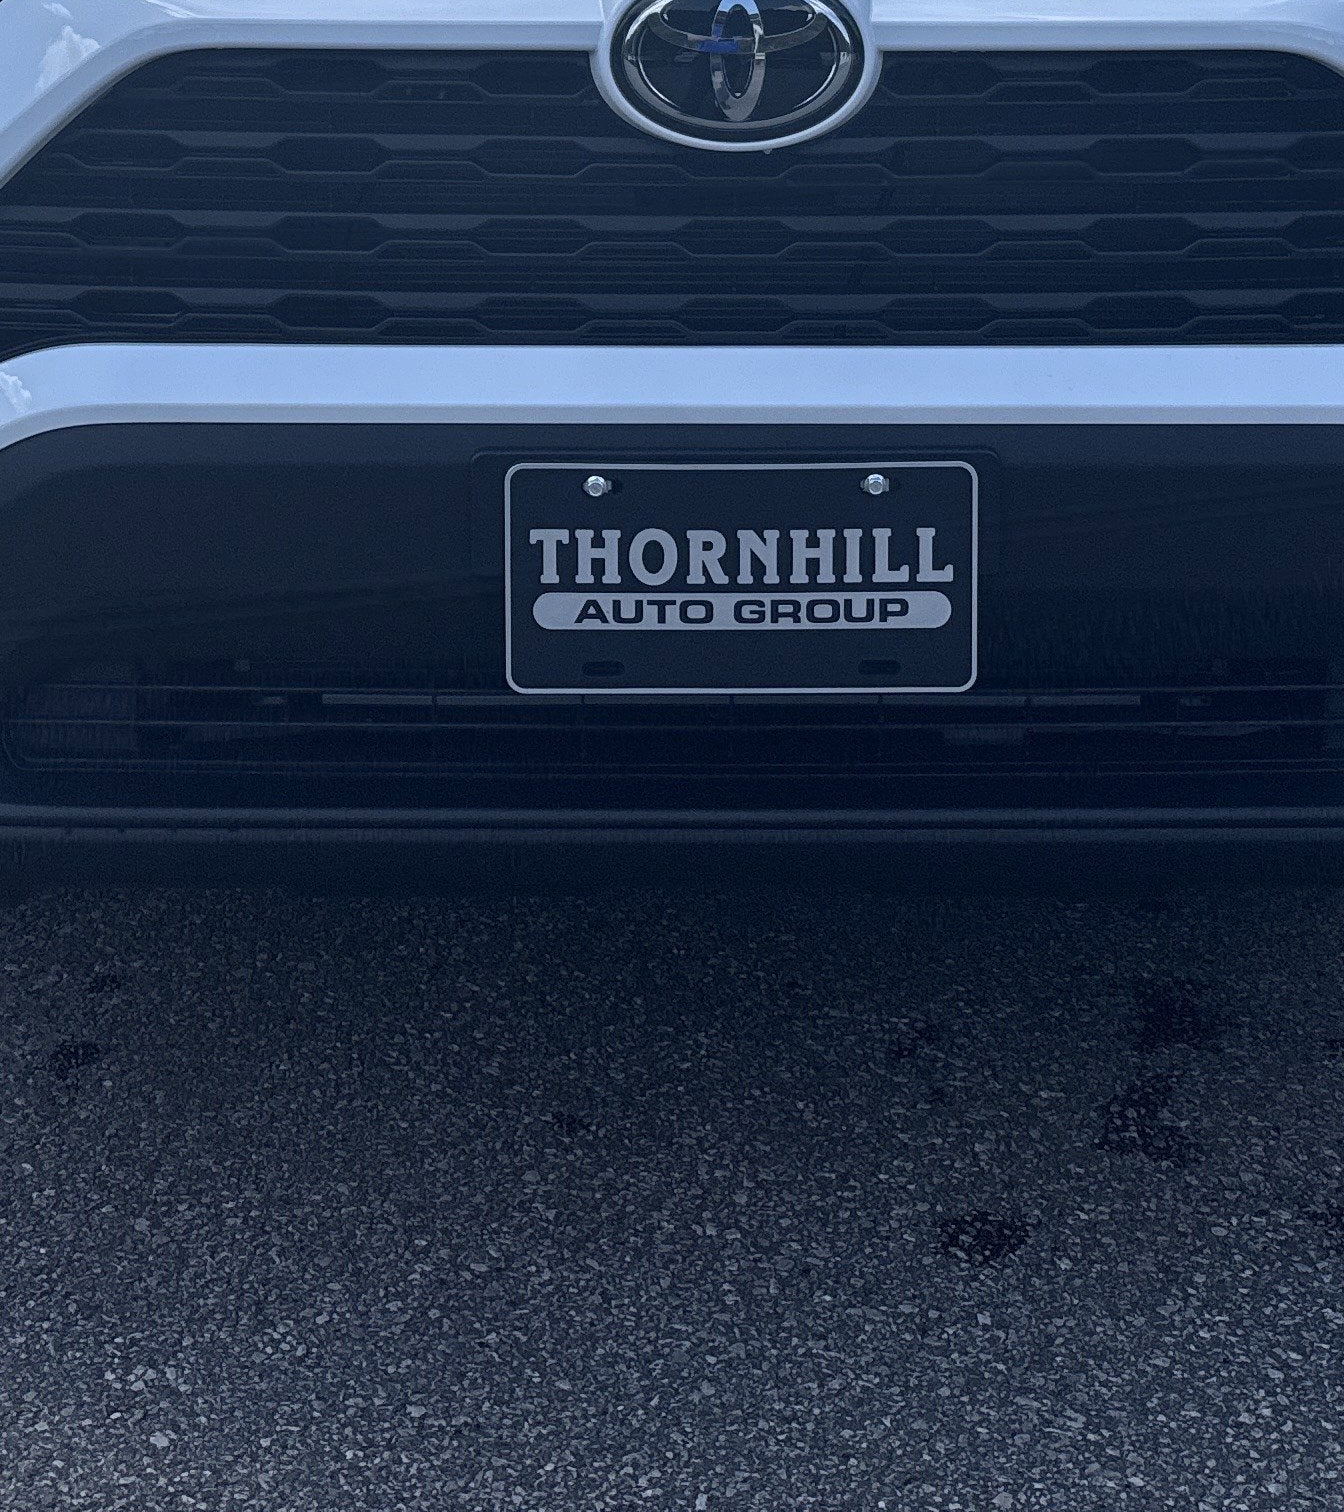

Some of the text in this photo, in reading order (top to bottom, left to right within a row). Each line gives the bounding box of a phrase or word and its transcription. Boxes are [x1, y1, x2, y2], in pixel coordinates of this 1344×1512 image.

[529, 528, 954, 586] THORNHILL
[574, 598, 910, 624] AUTO GROUP
